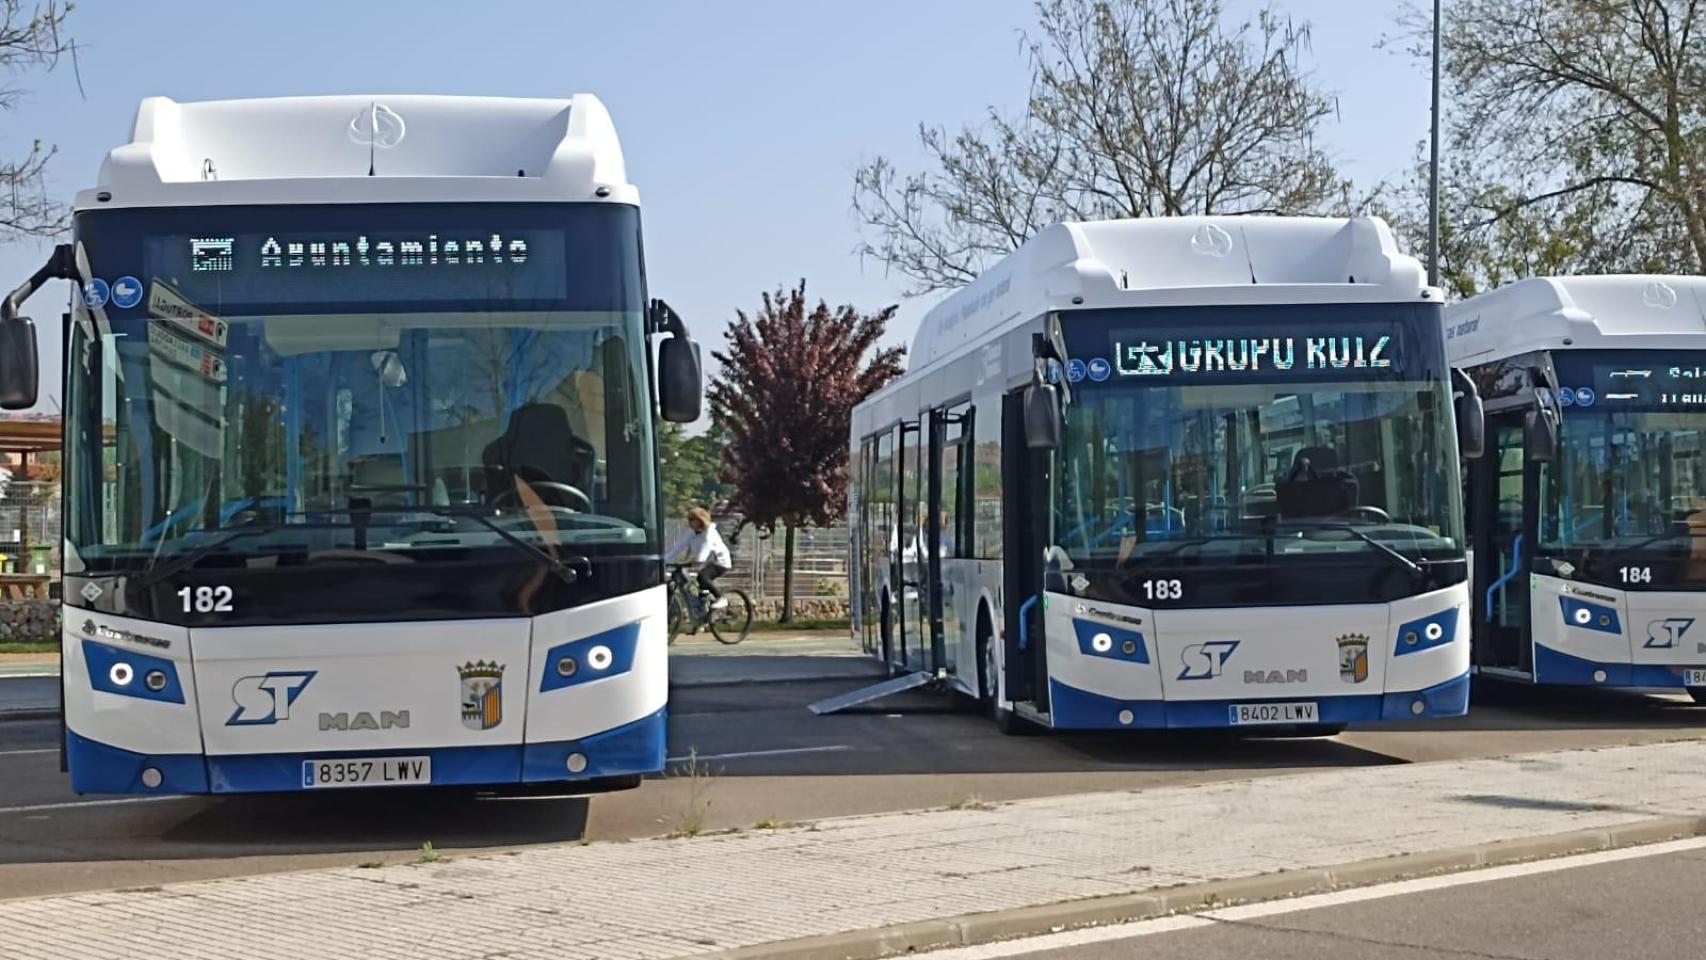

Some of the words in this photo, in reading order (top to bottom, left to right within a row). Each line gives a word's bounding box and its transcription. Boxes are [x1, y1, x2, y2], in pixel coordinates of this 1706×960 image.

[261, 235, 526, 266] Ayuntamiento
[1619, 566, 1652, 583] 184
[177, 585, 233, 612] 182
[1143, 579, 1182, 599] 183
[1177, 640, 1241, 680] ST
[1243, 668, 1308, 684] MAN
[226, 671, 318, 726] ST
[318, 710, 410, 731] MAN
[1240, 705, 1279, 721] 8402
[1285, 705, 1313, 720] LWV
[319, 762, 373, 783] 8357
[383, 761, 423, 781] LWV
